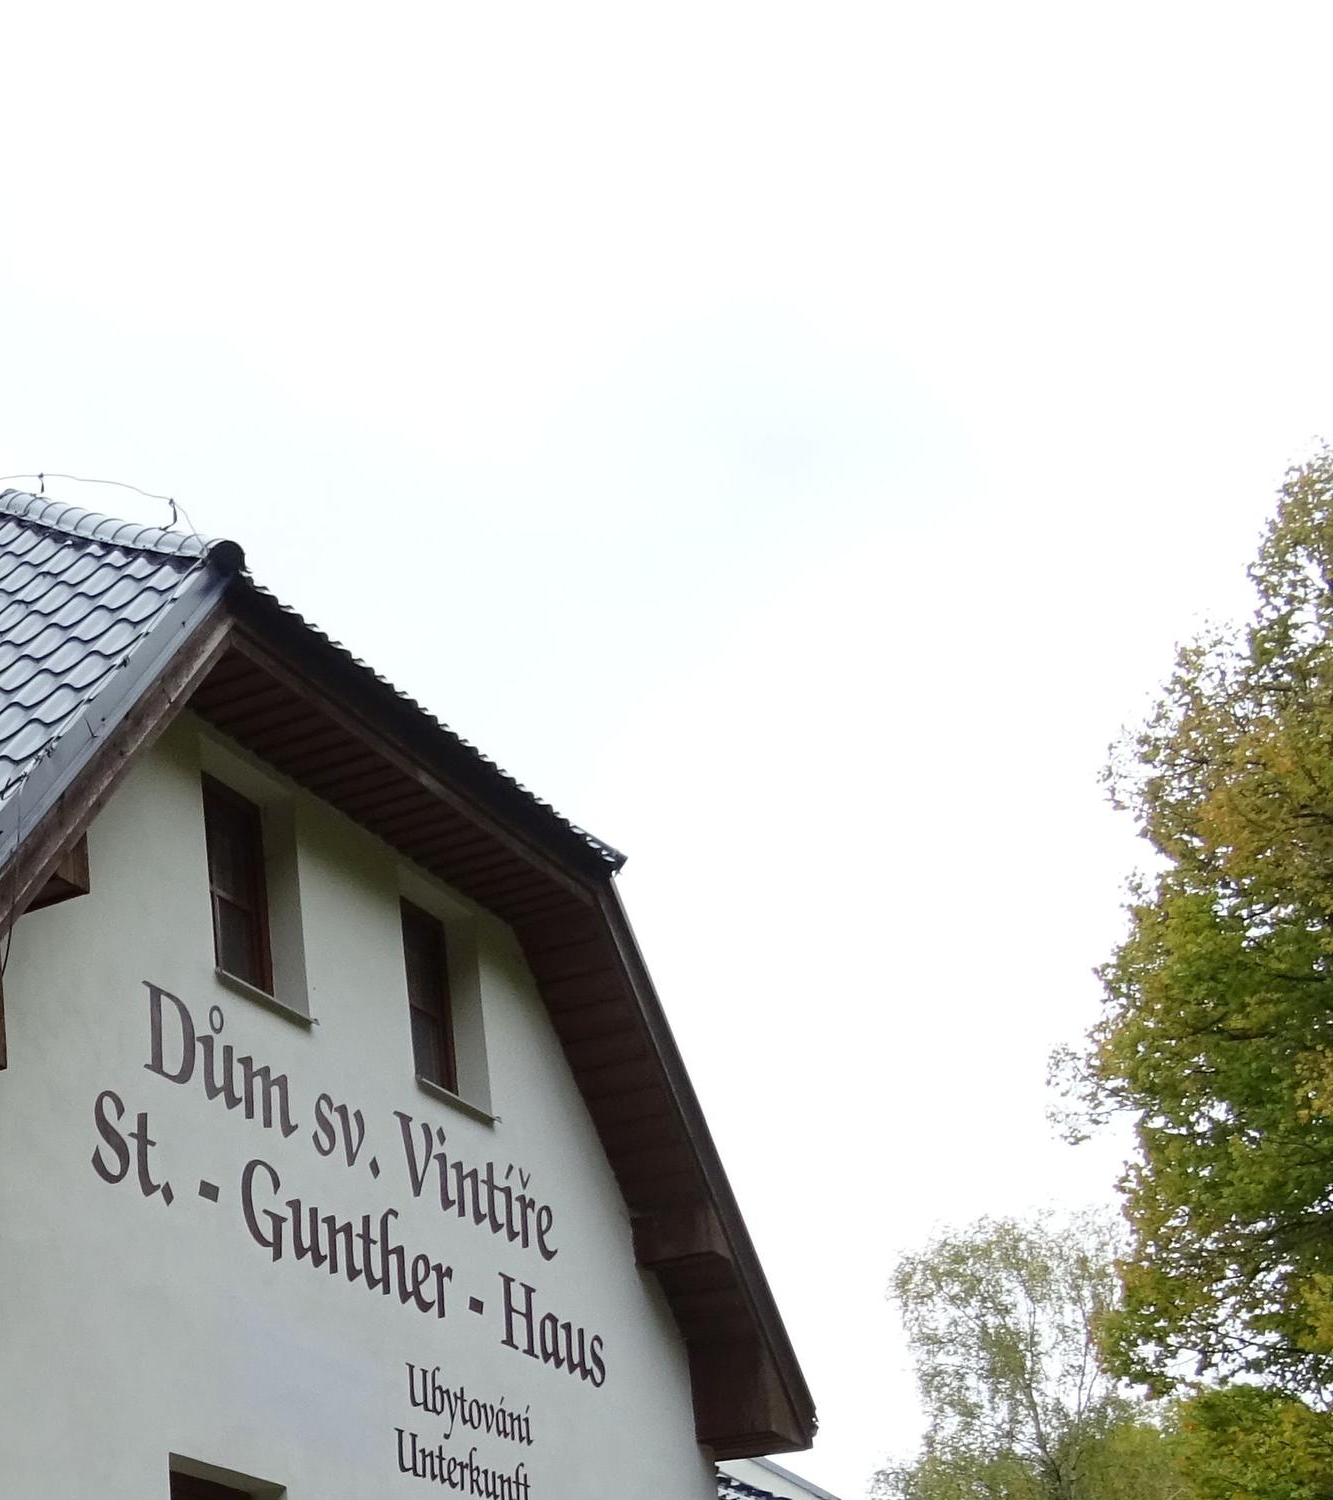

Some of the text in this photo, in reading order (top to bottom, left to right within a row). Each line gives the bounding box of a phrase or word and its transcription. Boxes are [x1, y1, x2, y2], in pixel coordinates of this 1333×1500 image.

[91, 1090, 174, 1207] St.
[241, 1158, 454, 1319] Gunther
[497, 1271, 606, 1388] Haus
[141, 980, 559, 1262] Dům sv. Vintíře
[405, 1361, 533, 1446] Ubytování
